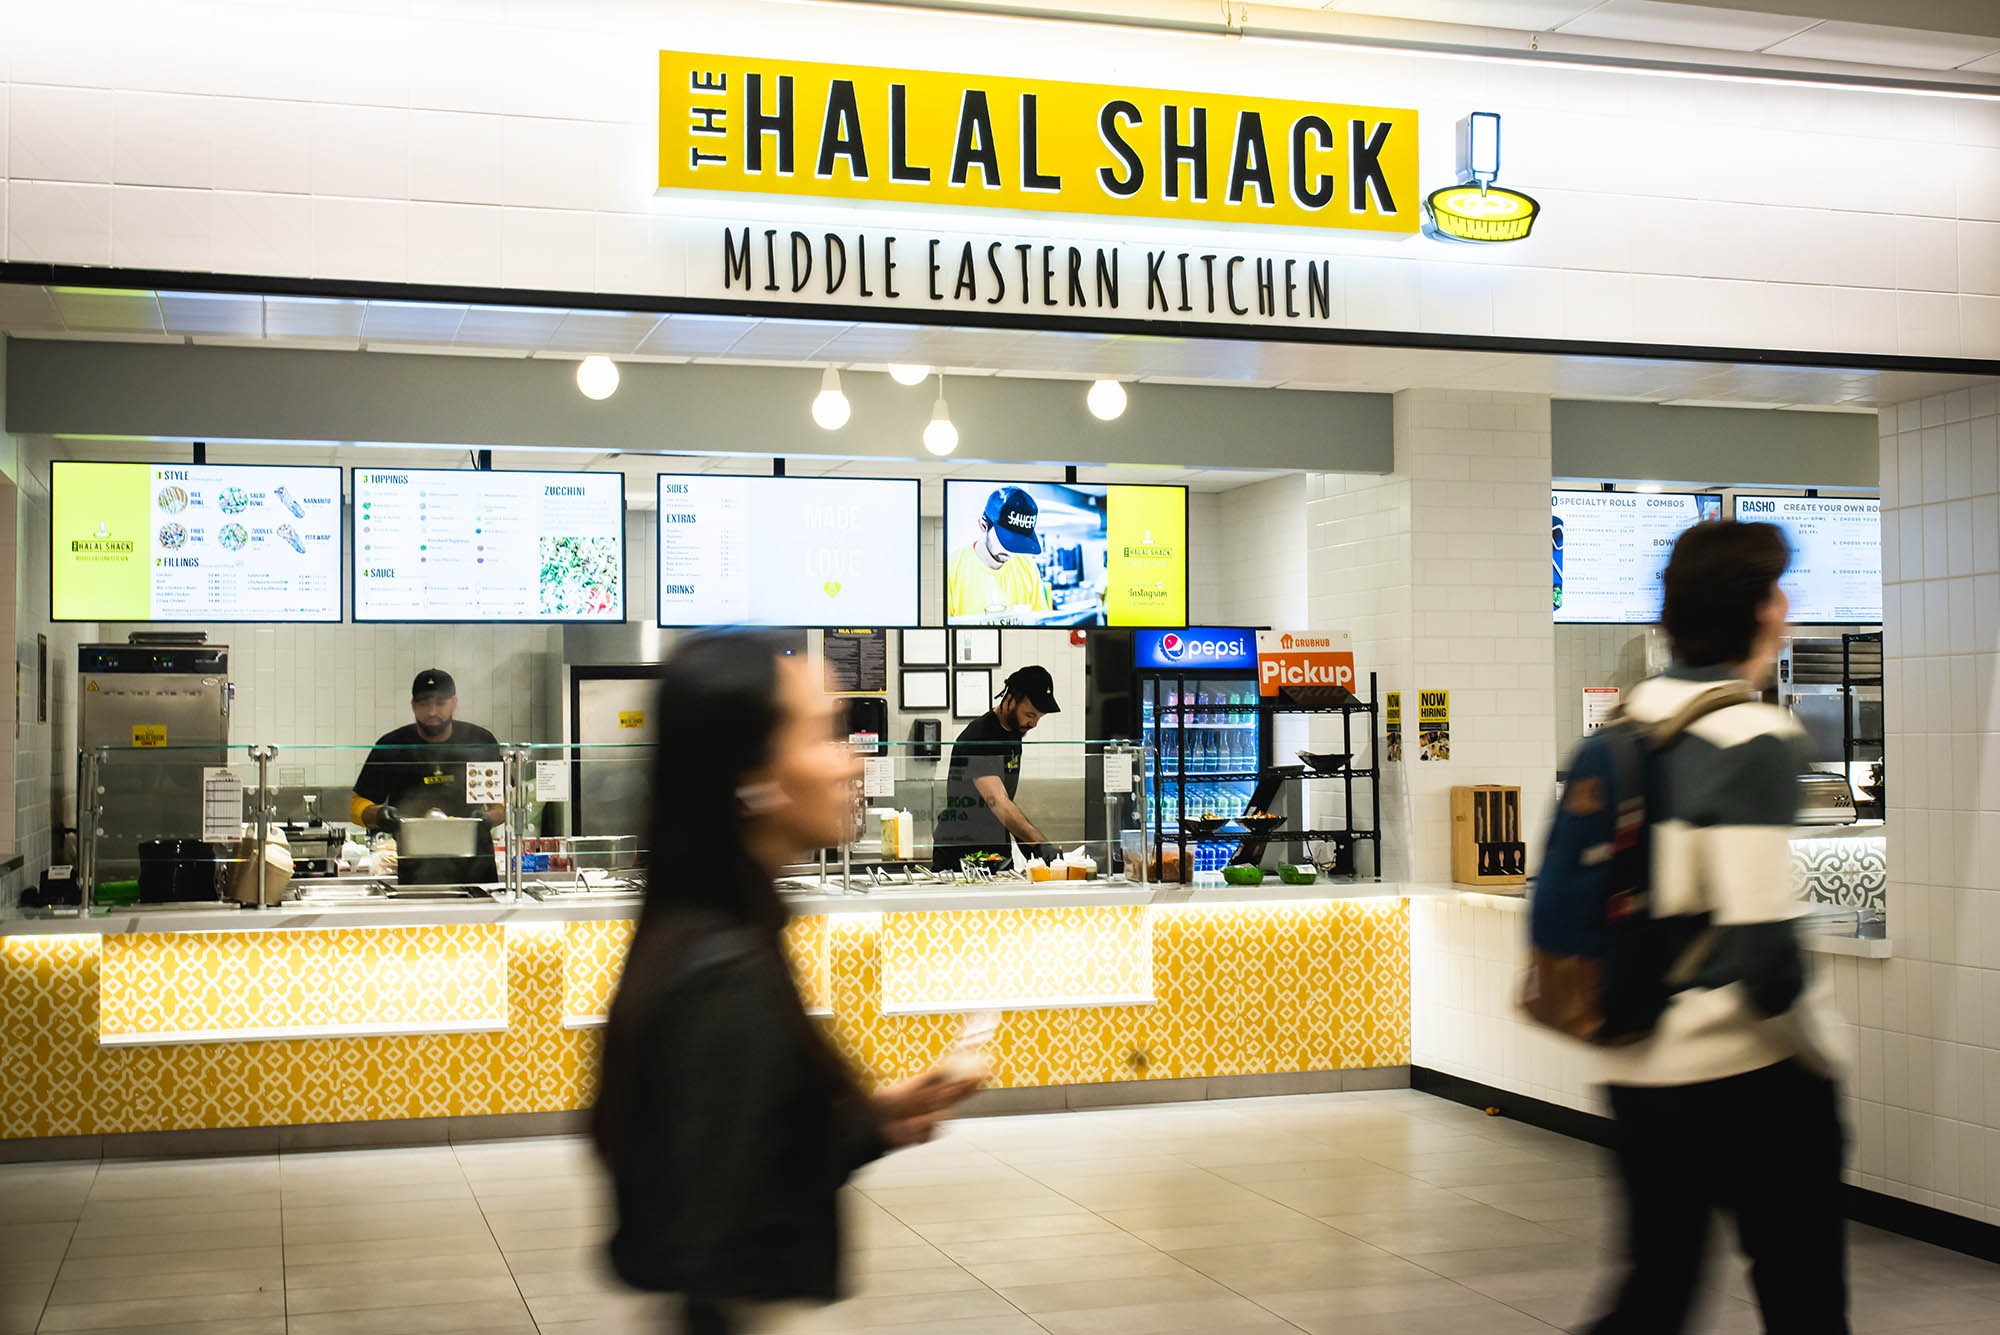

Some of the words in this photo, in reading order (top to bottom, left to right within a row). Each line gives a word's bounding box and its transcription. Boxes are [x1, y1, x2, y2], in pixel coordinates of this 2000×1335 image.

[691, 69, 727, 167] THE
[744, 72, 1062, 192] HALAL
[1097, 99, 1398, 215] SHACK
[724, 227, 898, 299] MIDDLE
[928, 239, 1120, 310] EASTERN
[1147, 250, 1332, 320] KITCHEN
[164, 470, 189, 481] STYLE
[370, 474, 409, 485] TOPPINGS
[544, 485, 585, 497] ZUCCHINI
[666, 483, 689, 494] SIDES
[1559, 497, 1607, 507] SPECIALTY
[1609, 498, 1637, 507] ROLLS
[1646, 499, 1685, 508] COMBOS
[1742, 501, 1775, 513] BASHO
[1783, 503, 1817, 512] CREATE
[1818, 504, 1841, 512] YOUR
[1843, 504, 1865, 512] OWN
[666, 513, 697, 524] EXTRAS
[164, 557, 199, 568] FILLINGS
[370, 567, 395, 578] SAUCE
[666, 584, 695, 595] DRINKS
[1128, 587, 1168, 600] Instagram
[1188, 637, 1245, 659] pepsi
[1295, 638, 1330, 648] GRUBHUB
[1261, 659, 1352, 686] Pickup
[1421, 692, 1446, 707] NOW
[1421, 707, 1447, 718] HIRING
